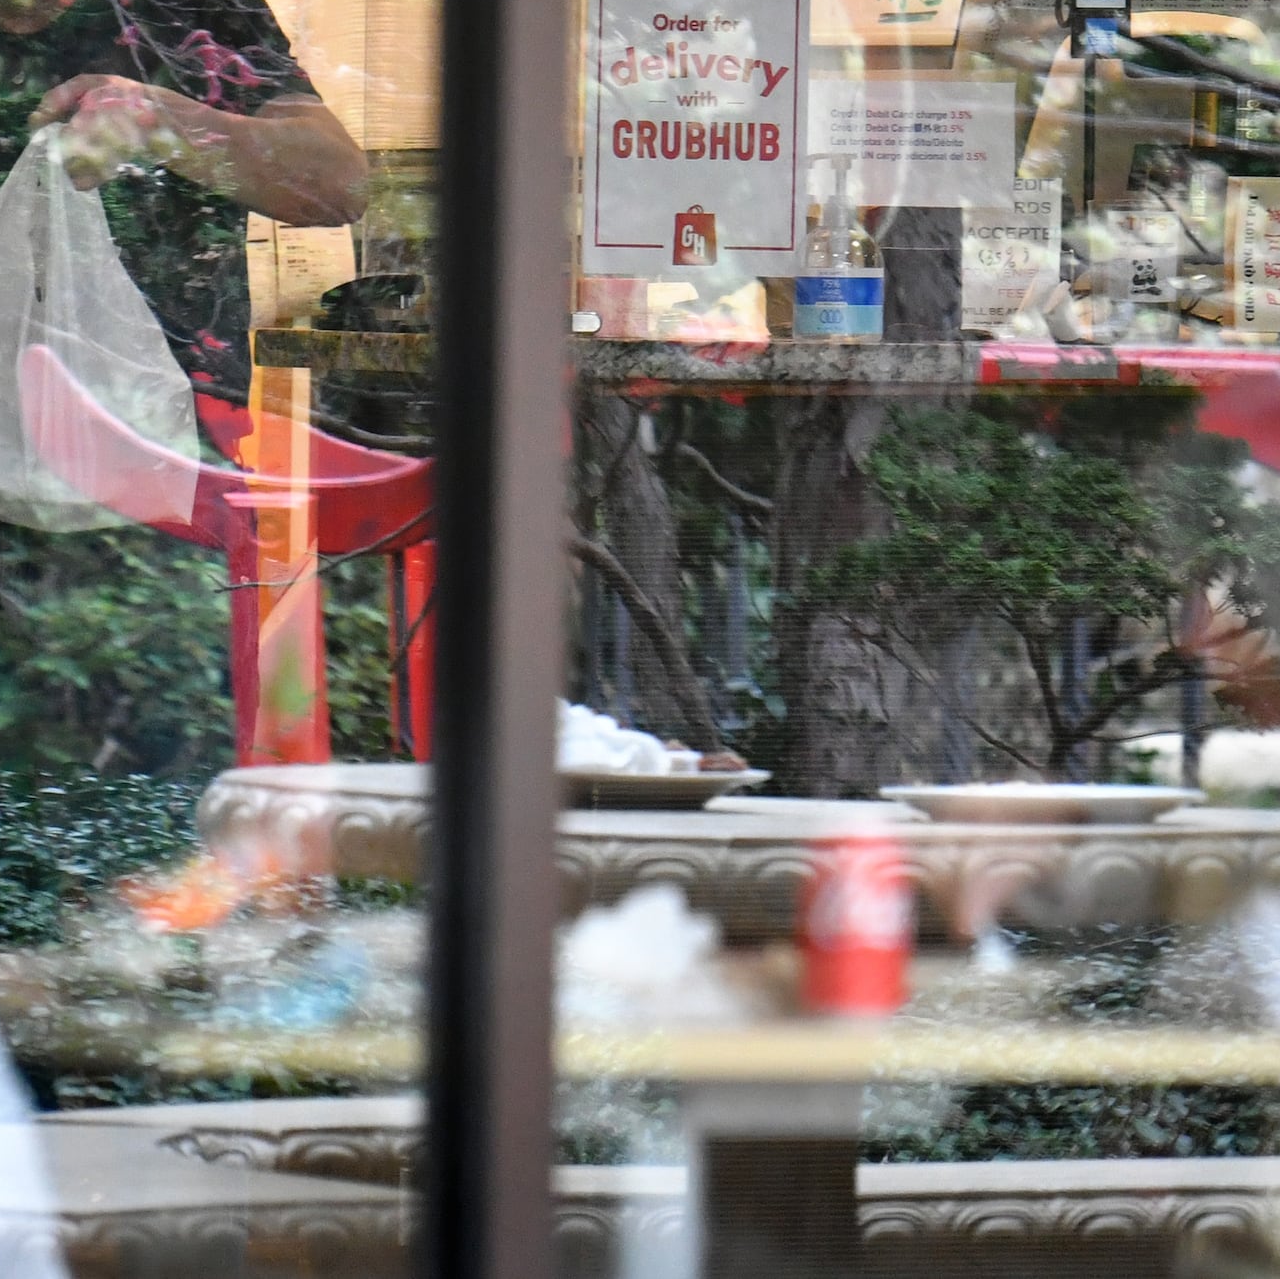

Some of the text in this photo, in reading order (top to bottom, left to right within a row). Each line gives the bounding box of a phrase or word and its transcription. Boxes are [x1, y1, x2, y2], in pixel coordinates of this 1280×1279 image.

[652, 13, 740, 32] Order for
[610, 40, 790, 98] delivery
[676, 91, 718, 108] with
[612, 118, 781, 162] GRUBHUB
